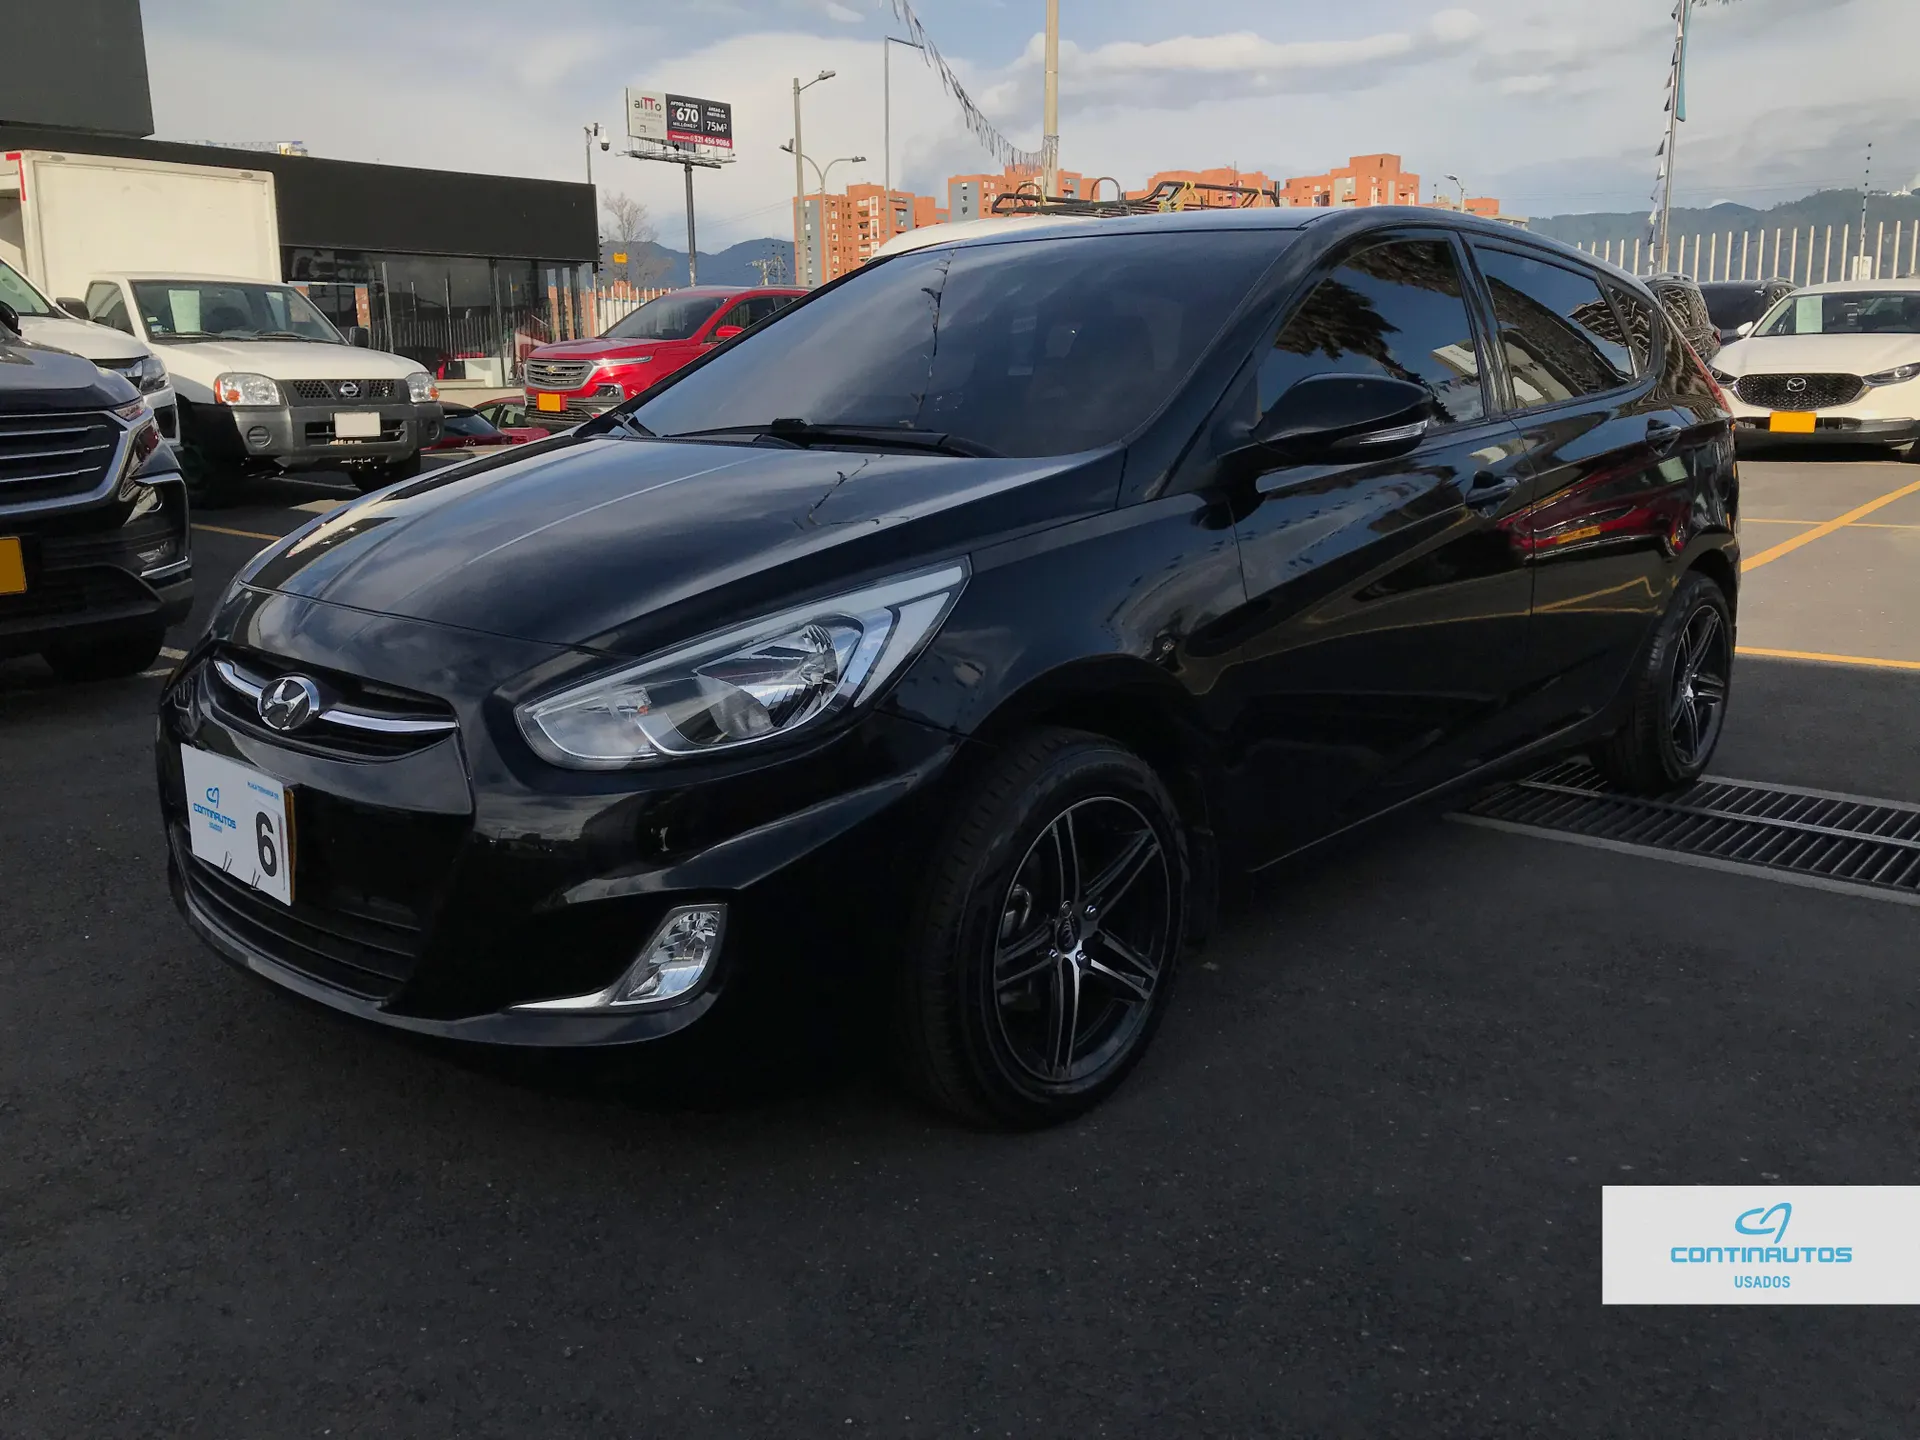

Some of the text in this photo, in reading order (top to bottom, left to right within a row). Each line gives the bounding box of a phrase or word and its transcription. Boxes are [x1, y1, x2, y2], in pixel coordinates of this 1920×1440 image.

[694, 135, 704, 143] 321
[193, 802, 237, 829] CONTINAUTOS
[255, 811, 277, 878] 6
